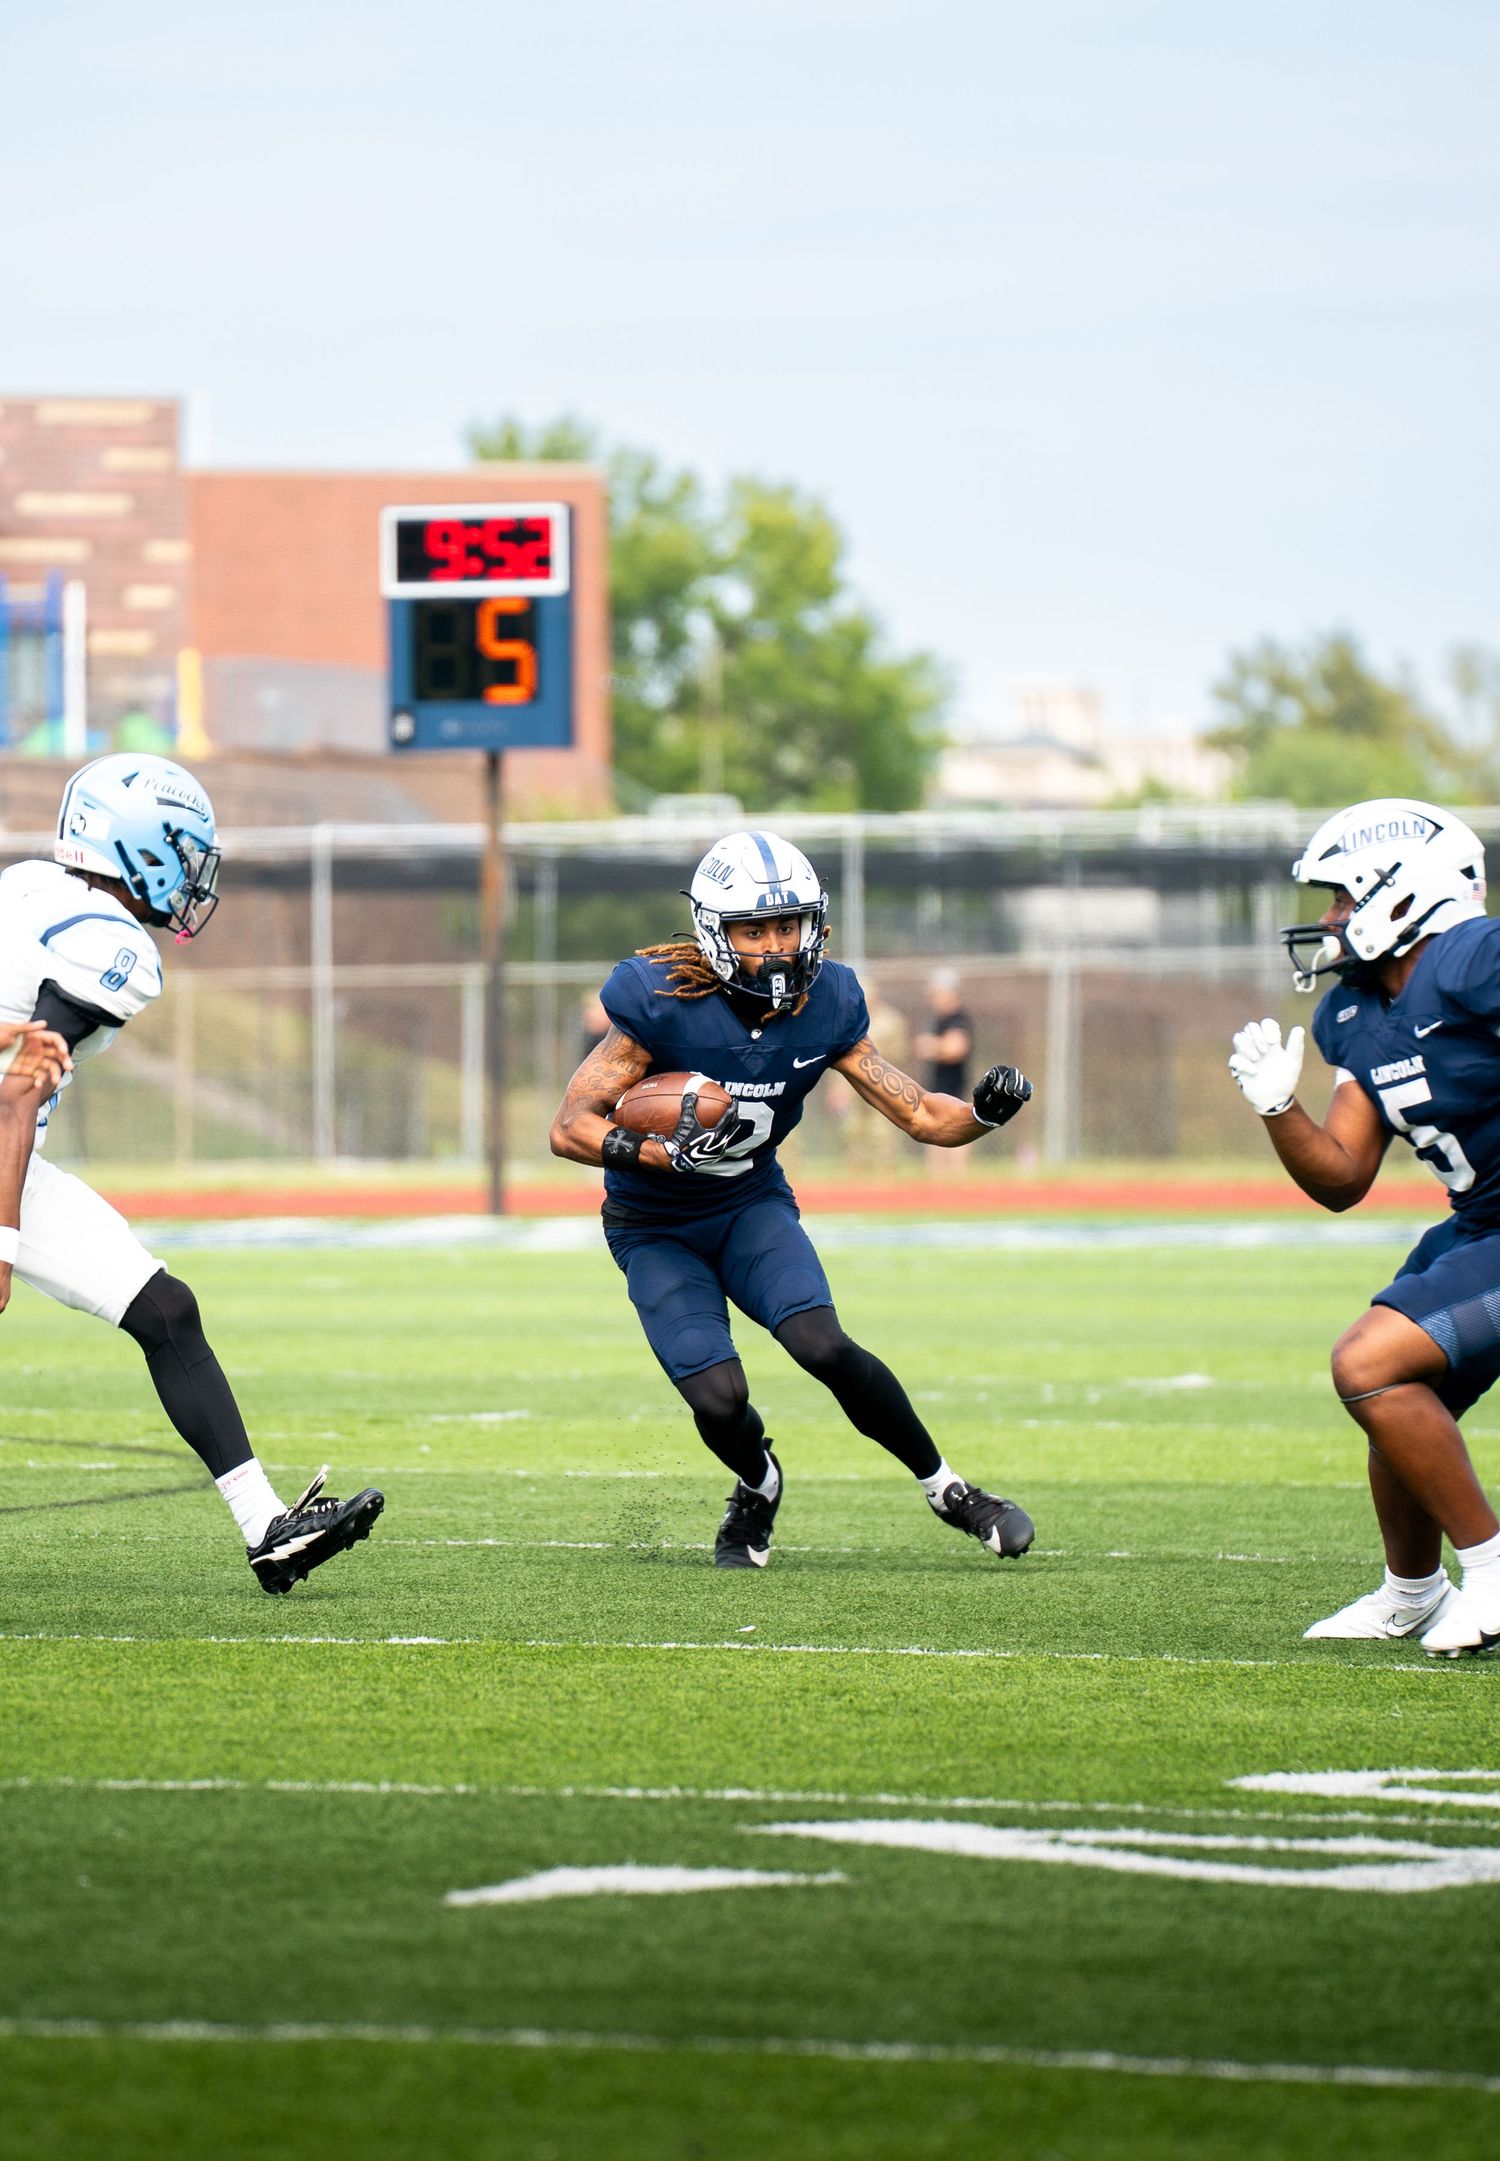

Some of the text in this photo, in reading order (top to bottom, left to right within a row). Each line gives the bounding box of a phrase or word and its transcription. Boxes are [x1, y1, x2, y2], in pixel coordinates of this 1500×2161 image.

[424, 517, 551, 580] 9:52
[476, 597, 537, 706] 5
[1337, 819, 1426, 855] LINCOLN
[100, 947, 137, 992] 8
[718, 1081, 787, 1098] INCOLN
[860, 1056, 920, 1112] 809
[1370, 1055, 1426, 1086] LINCOLN
[1377, 1077, 1476, 1192] 5
